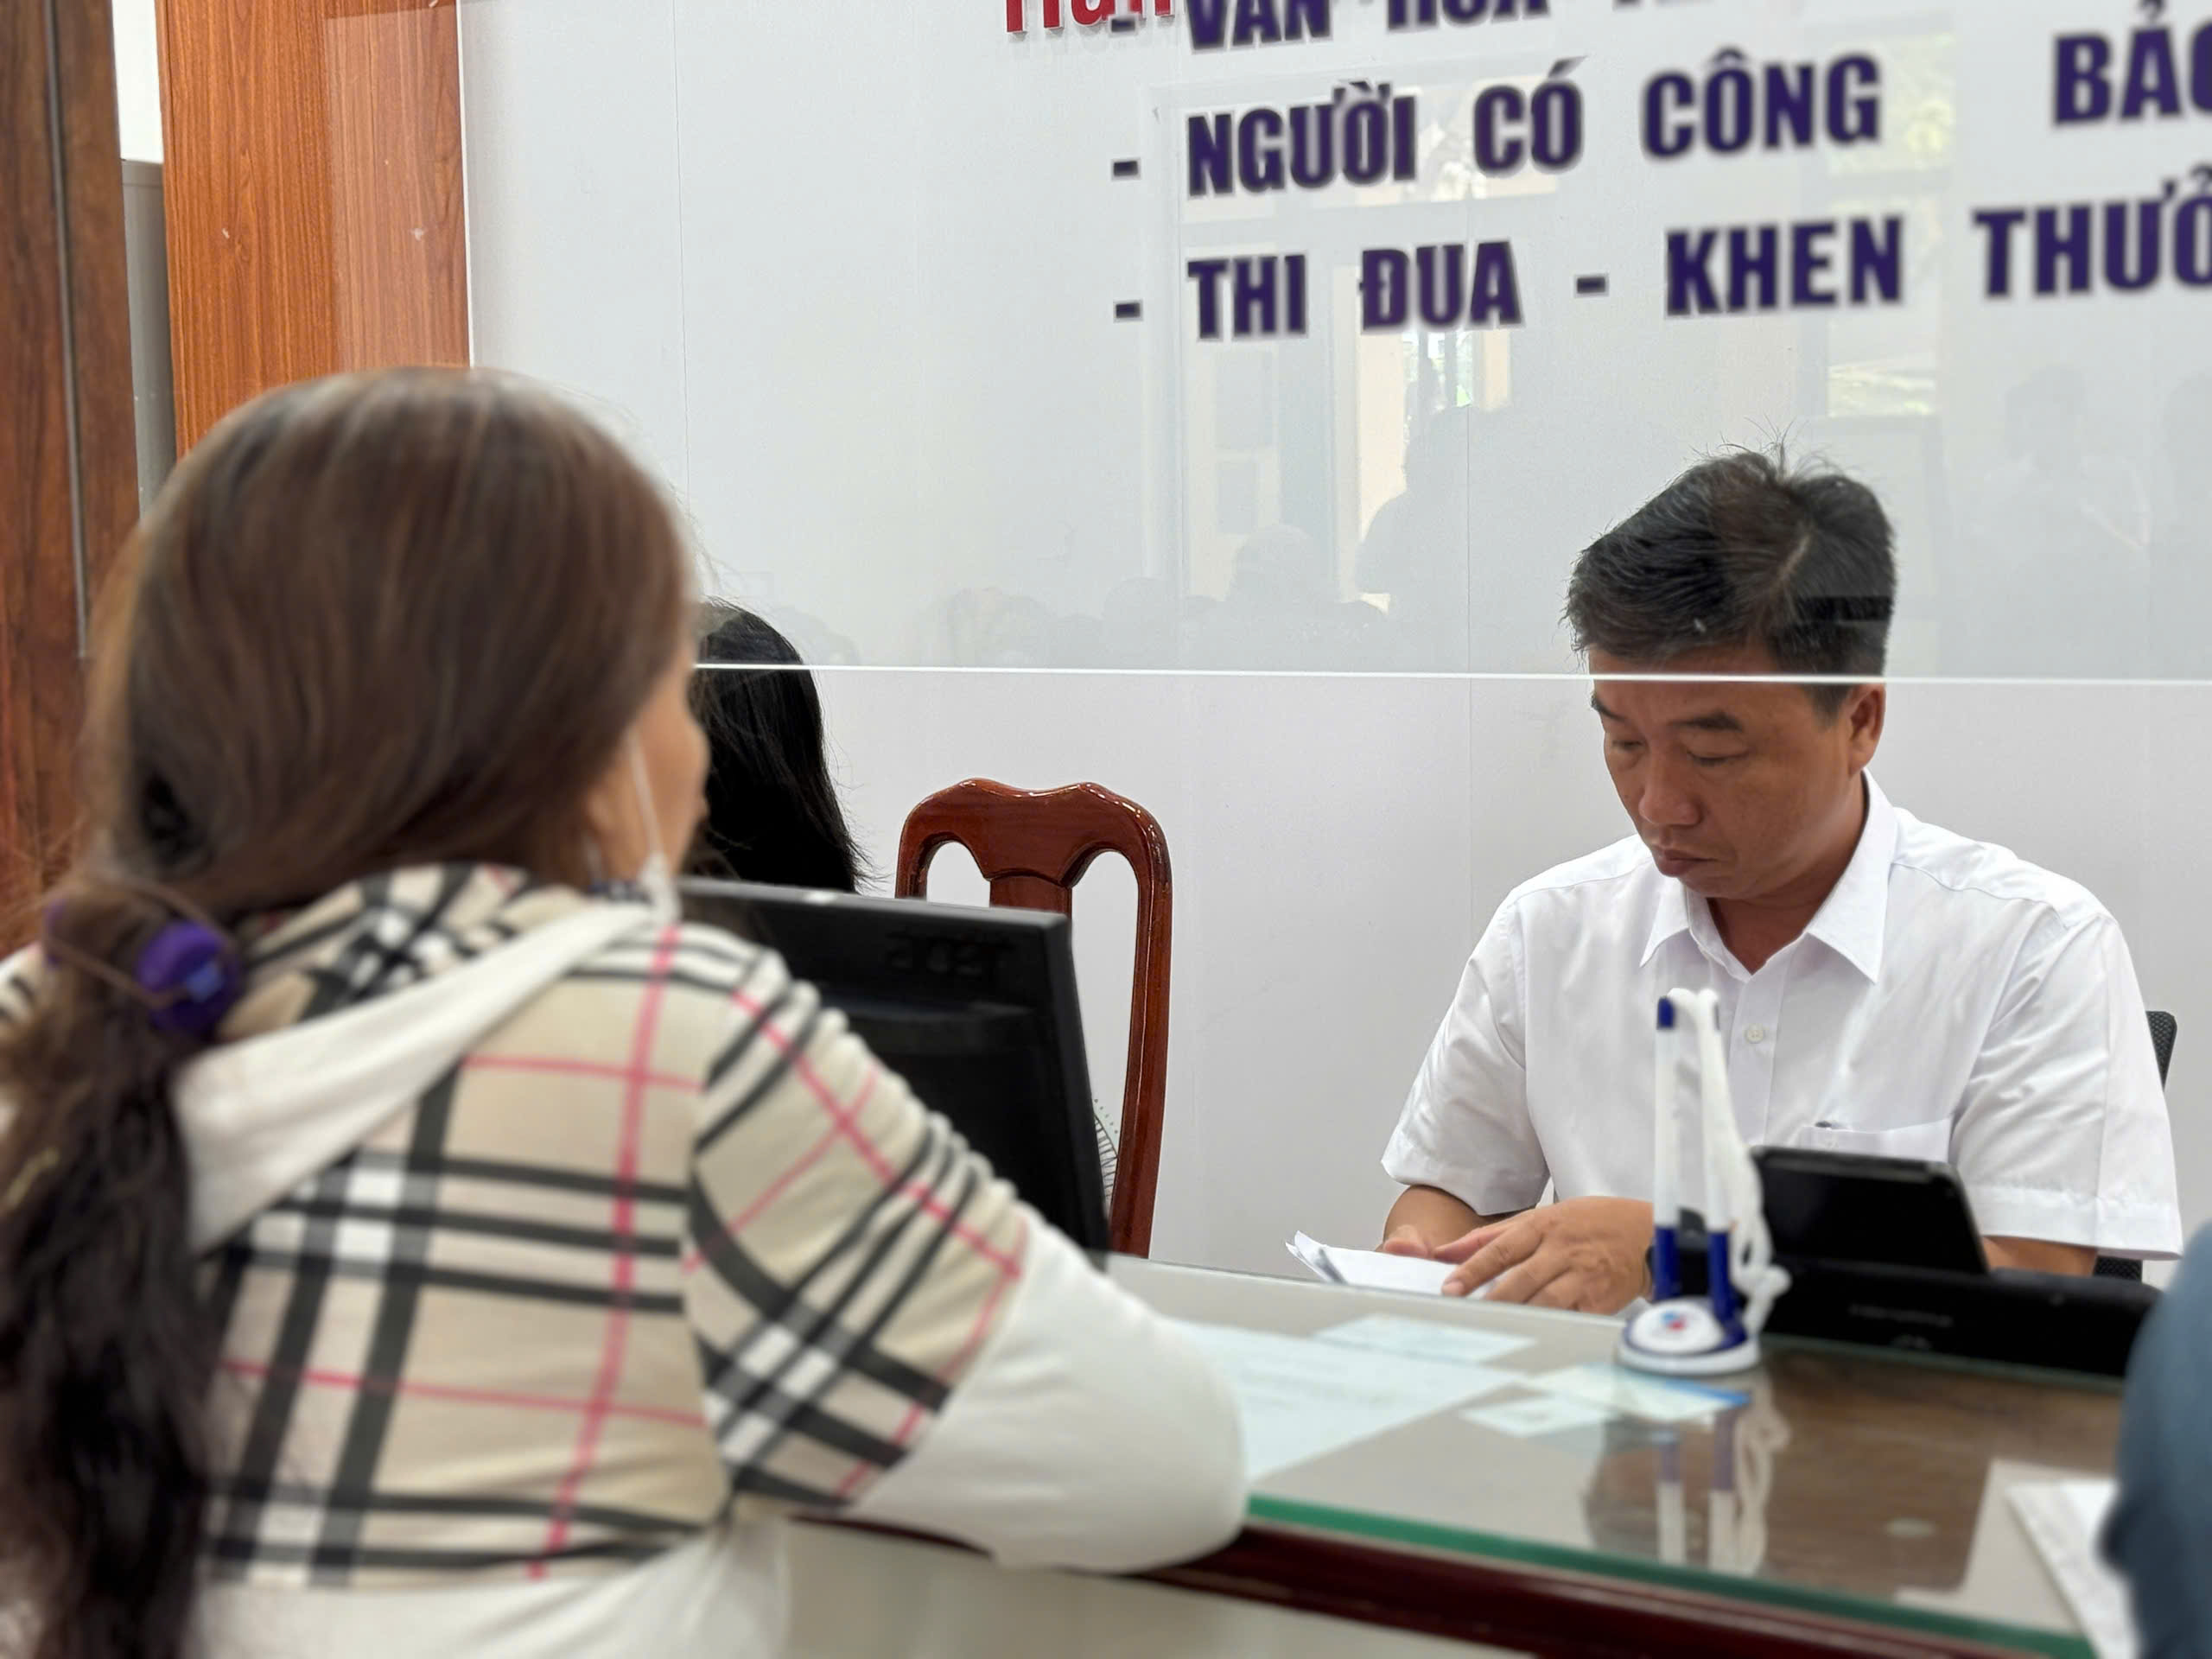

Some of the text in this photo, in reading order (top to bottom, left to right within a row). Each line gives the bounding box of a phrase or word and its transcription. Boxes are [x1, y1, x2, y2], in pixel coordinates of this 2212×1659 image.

[1188, 80, 1415, 197] NGƯỜI
[1473, 57, 1583, 175] CÓ
[1642, 48, 1879, 161] CÔNG
[1187, 254, 1307, 340] THI
[1358, 240, 1522, 330] ĐUA
[1667, 216, 1903, 316] KHEN
